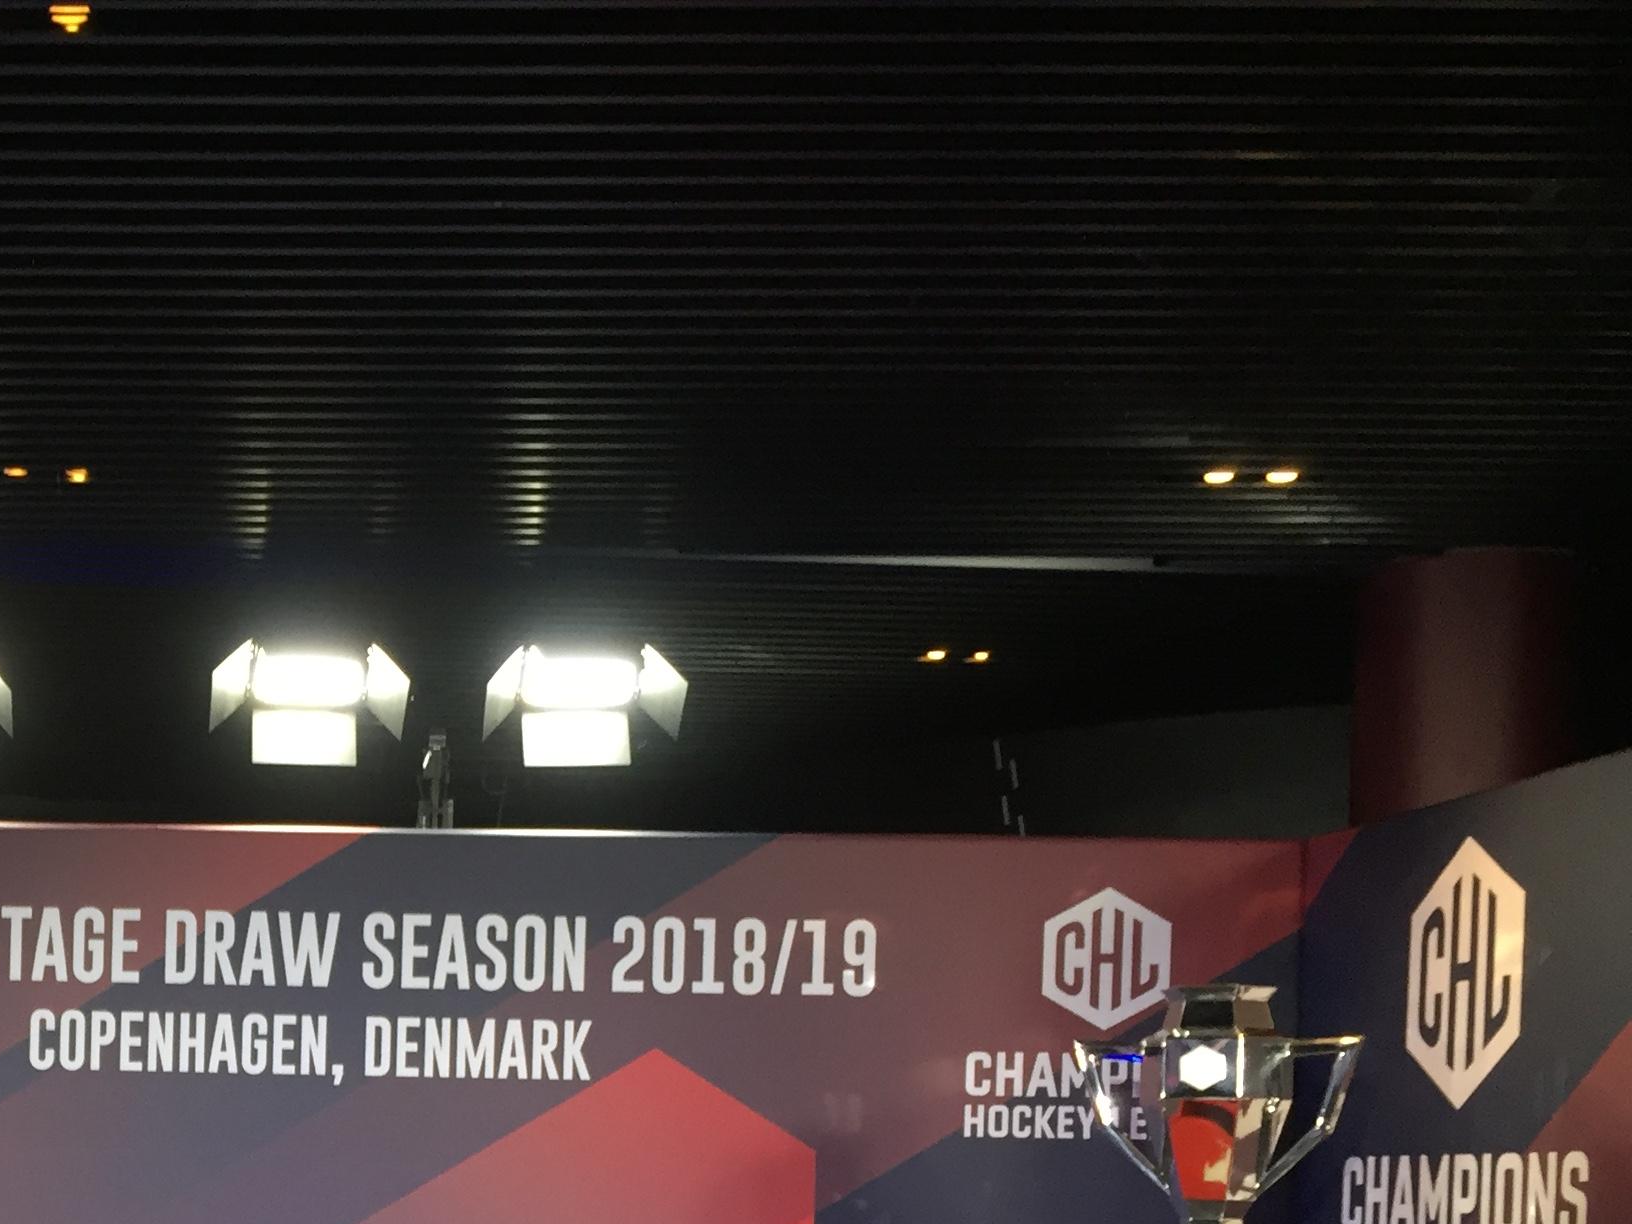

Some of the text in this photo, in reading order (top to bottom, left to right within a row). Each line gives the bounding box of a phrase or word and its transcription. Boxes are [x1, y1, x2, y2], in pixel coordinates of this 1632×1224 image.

[165, 908, 342, 990] DRAW
[361, 911, 588, 993] SEASON
[611, 915, 877, 999] 2018/19
[1054, 906, 1160, 1012] CHL
[1418, 874, 1513, 1074] CHL
[28, 1009, 591, 1086] COPENHAGEN, DENMARK
[963, 1104, 1096, 1140] HOCKEY
